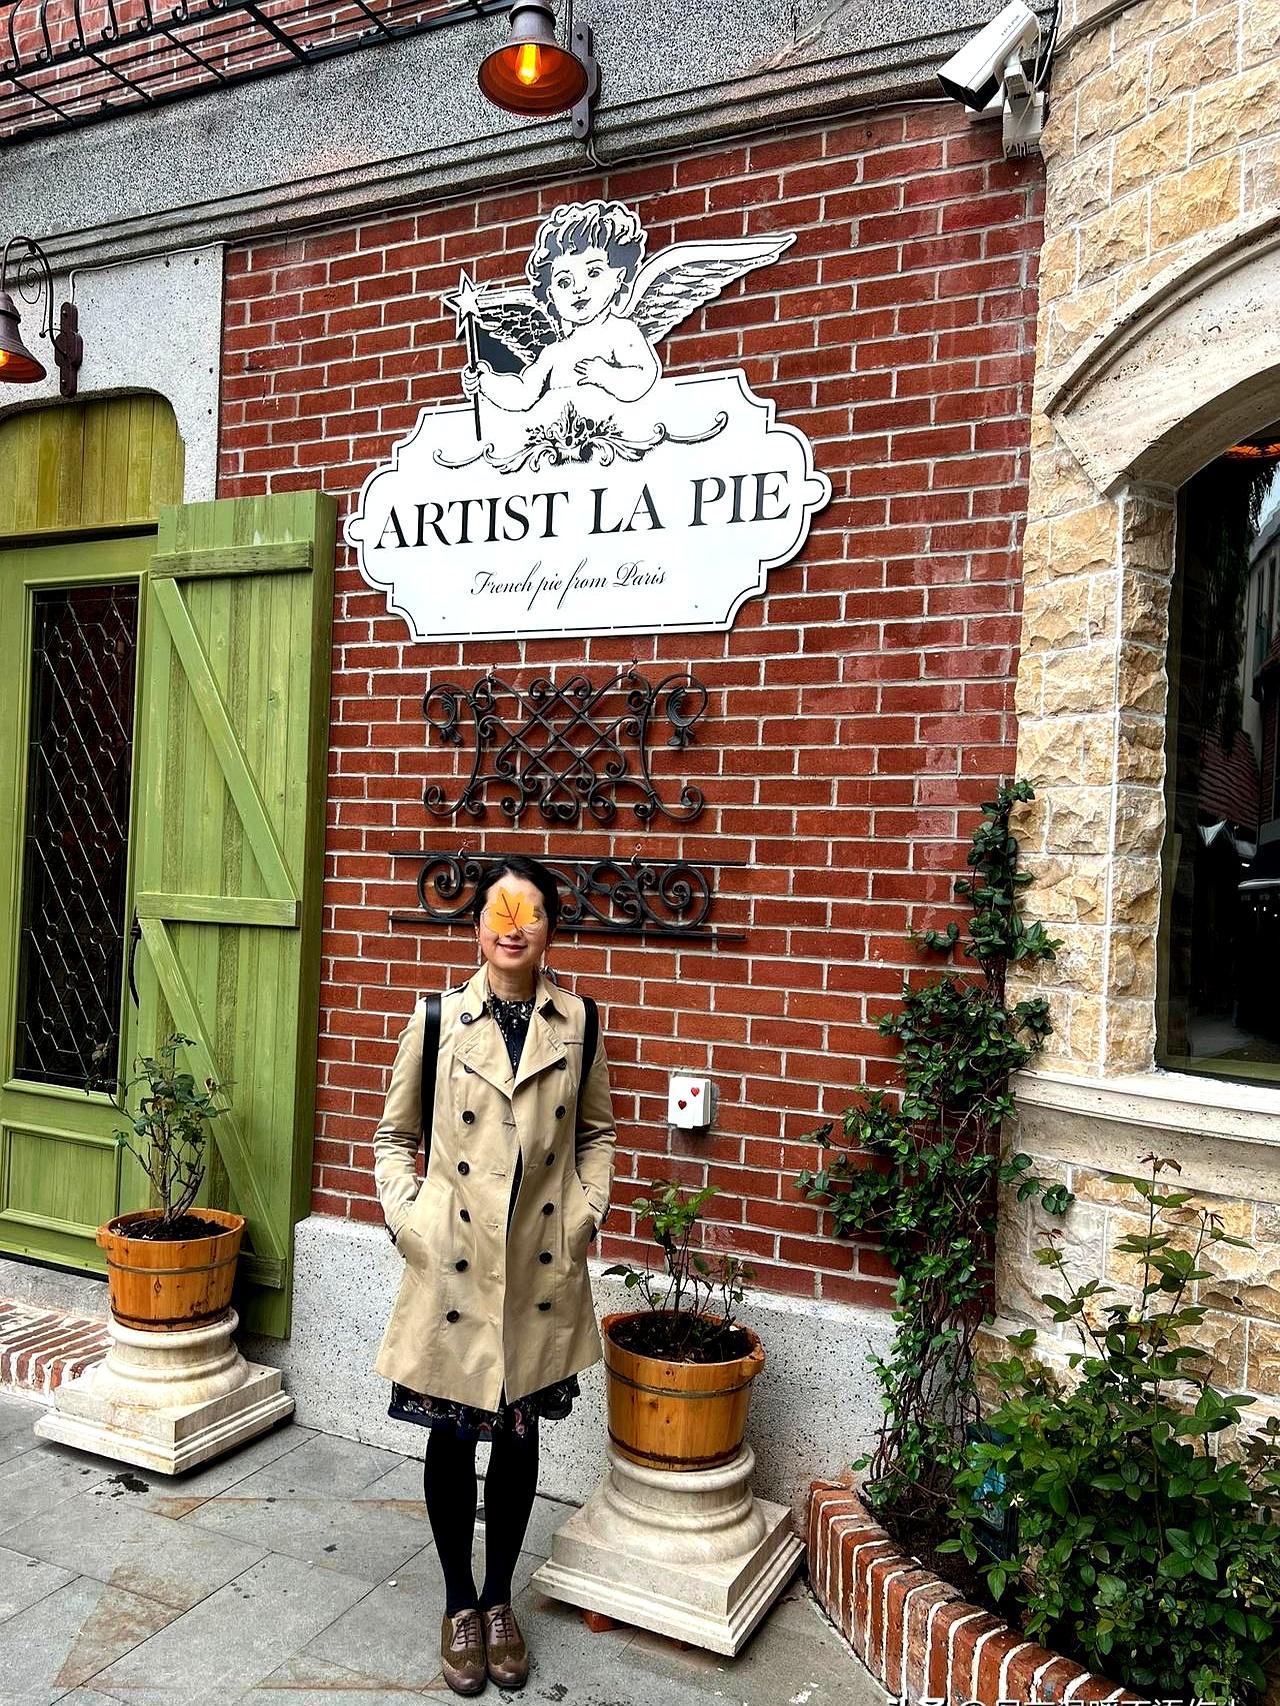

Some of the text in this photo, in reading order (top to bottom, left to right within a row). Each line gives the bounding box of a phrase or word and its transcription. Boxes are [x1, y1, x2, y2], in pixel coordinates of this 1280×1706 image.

[374, 470, 791, 550] ARTIST LA PIE
[470, 557, 666, 611] French pie from Paris
